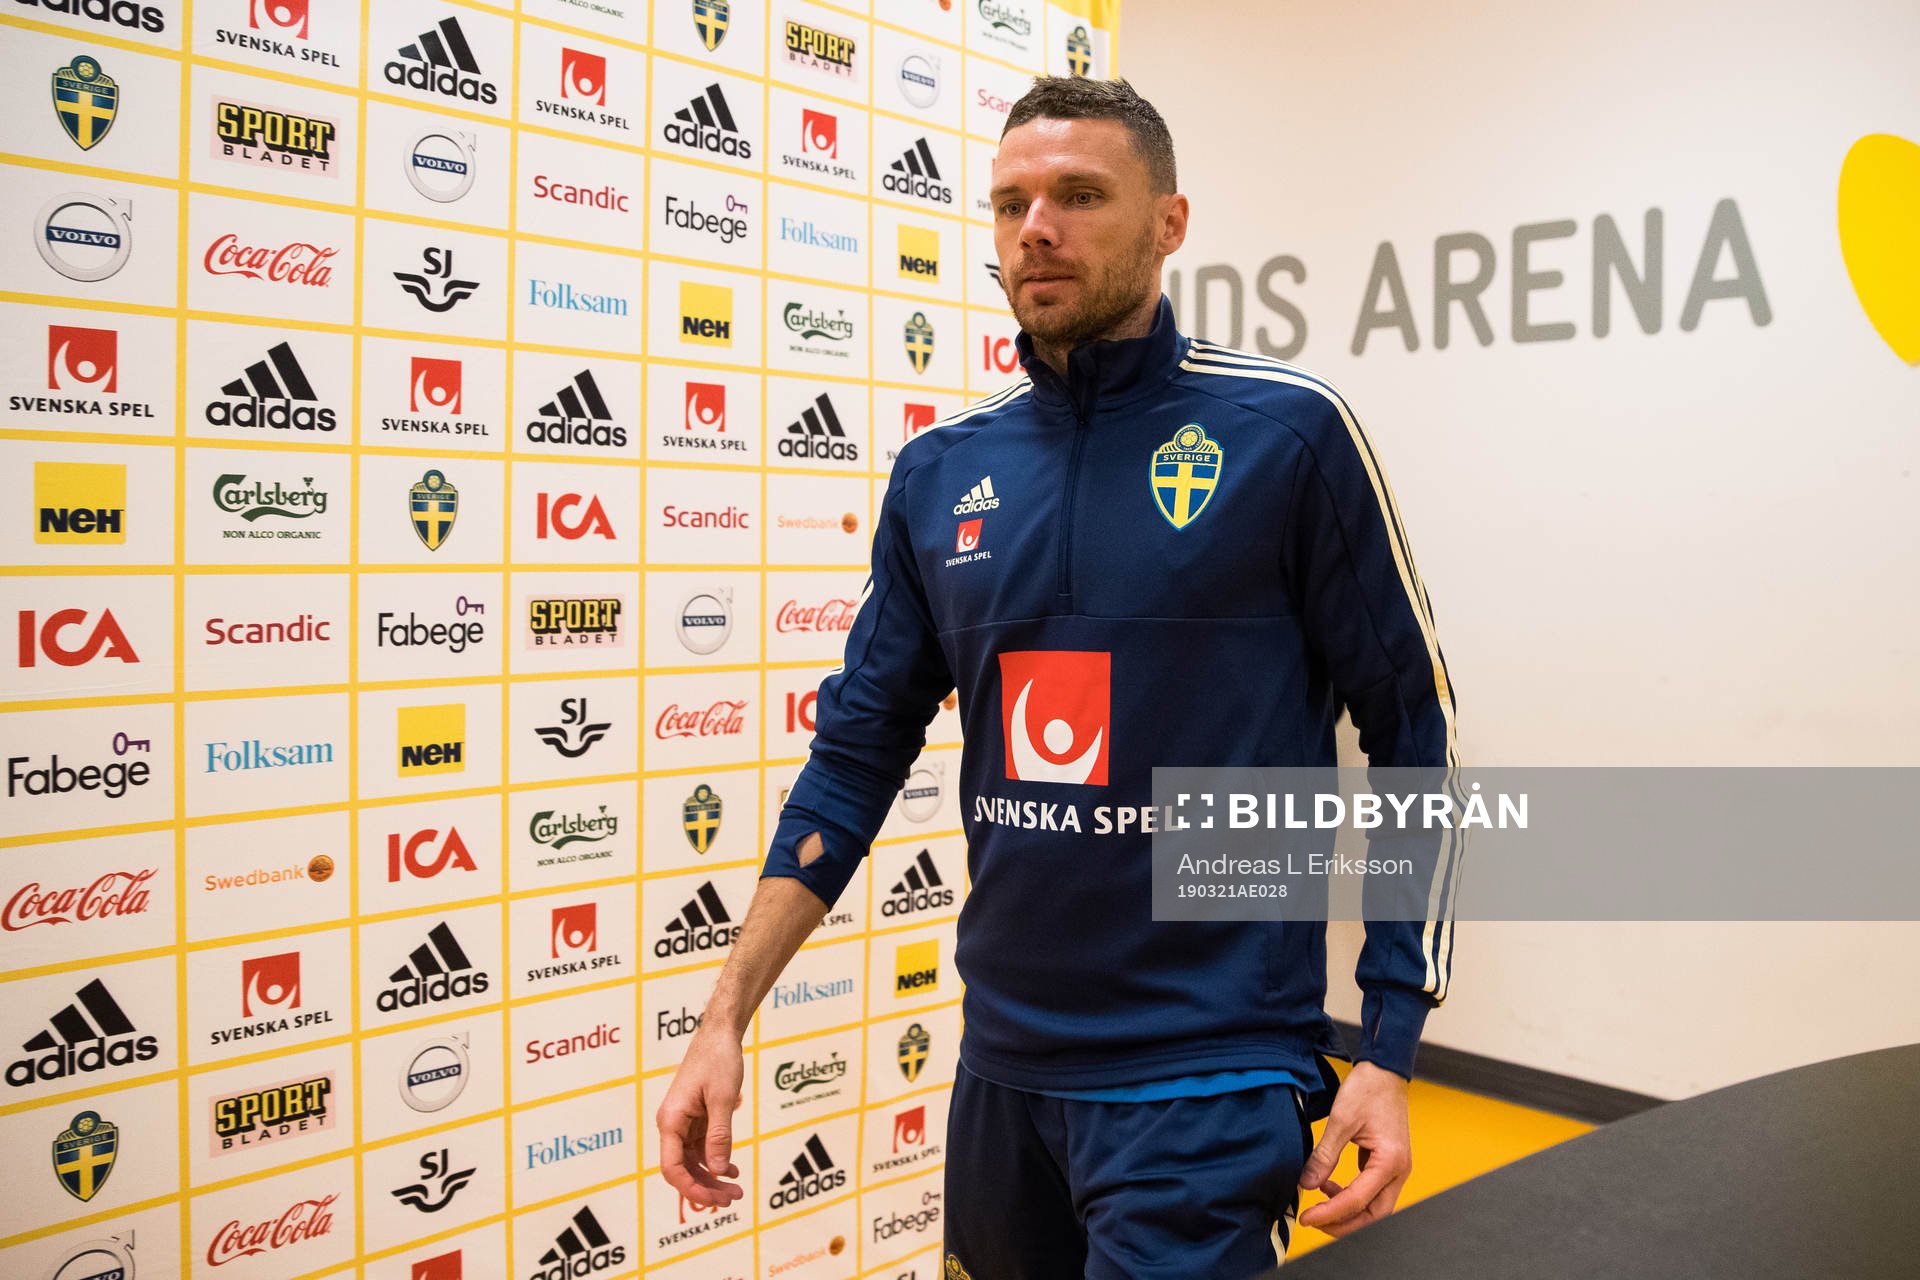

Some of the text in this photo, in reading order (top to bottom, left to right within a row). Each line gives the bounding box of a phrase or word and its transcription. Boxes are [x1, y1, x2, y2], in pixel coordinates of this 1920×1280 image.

[215, 28, 340, 68] SVENSKA SPEL
[786, 20, 855, 67] SPORT
[789, 51, 853, 78] BLADET
[61, 78, 109, 95] SVERIGE
[384, 60, 498, 105] adidas
[217, 103, 336, 158] SPORT
[535, 100, 630, 130] SVENSKA SPEL
[663, 122, 752, 159] adidas
[223, 144, 330, 172] BLADET
[414, 155, 465, 174] VOLVO
[782, 155, 857, 181] SVENSKA SPEL
[533, 174, 629, 213] Scandic
[883, 172, 952, 204] adidas
[665, 196, 747, 244] Fabege
[779, 216, 859, 254] Folksam
[50, 228, 118, 247] VOLVO
[204, 233, 341, 288] Coca-Cola
[423, 246, 452, 279] SJ
[1351, 198, 1773, 357] ARENA
[528, 279, 629, 317] Folksam
[783, 301, 854, 342] Carlsberg
[983, 335, 1029, 374] IC
[9, 396, 155, 419] SVENSKA SPEL
[206, 398, 337, 432] adidas
[382, 417, 489, 437] SVENSKA SPEL
[527, 415, 627, 448] adidas
[662, 435, 748, 452] SVENSKA SPEL
[778, 433, 858, 462] adidas
[1163, 452, 1212, 464] SVERIGE
[213, 474, 328, 521] Carlsberg
[953, 497, 1000, 516] adidas
[536, 492, 616, 540] ICA
[663, 505, 749, 529] Scandic
[777, 515, 839, 529] Swedbank
[222, 530, 321, 539] NON ALCO ORGANIC
[945, 551, 992, 568] SVENSKA SPEL
[206, 615, 330, 644] Scandic
[378, 613, 484, 653] Fabege
[530, 598, 621, 634] SPORT
[684, 615, 724, 626] VOLVO
[18, 607, 140, 667] ICA
[535, 634, 618, 645] BLADET
[561, 697, 586, 724] SJ
[655, 700, 750, 740] Coca-Cola
[786, 690, 819, 733] IC
[205, 740, 333, 772] Folksam
[8, 755, 150, 799] Fabege
[530, 805, 618, 849] Carlsberg
[975, 795, 1183, 834] SVENSKA SPEL
[388, 826, 478, 882] ICA
[204, 865, 304, 891] Swedbank
[1, 867, 159, 931] Coca-Cola
[882, 887, 954, 919] adidas
[829, 912, 854, 927] SPEL
[654, 924, 740, 958] adidas
[527, 955, 622, 982] SVENSKA SPEL
[376, 970, 489, 1013] adidas
[772, 975, 854, 1009] Folksam
[210, 1010, 333, 1045] SVENSKA SPEL
[526, 1023, 620, 1064] Scandic
[5, 1034, 158, 1087] adidas
[410, 1065, 459, 1085] VOLVO
[775, 1053, 847, 1093] Carlsberg
[214, 1077, 331, 1137] SPORT
[63, 1133, 109, 1151] SVERIGE
[221, 1116, 326, 1149] BLADET
[526, 1127, 623, 1170] Folksam
[419, 1148, 449, 1180] SJ
[873, 1145, 941, 1173] SVENSKA SPEL
[770, 1166, 846, 1210] adidas
[206, 1192, 340, 1267] Coca-Cola
[658, 1212, 739, 1248] SVENSKA SPEL
[873, 1204, 940, 1243] Fabege
